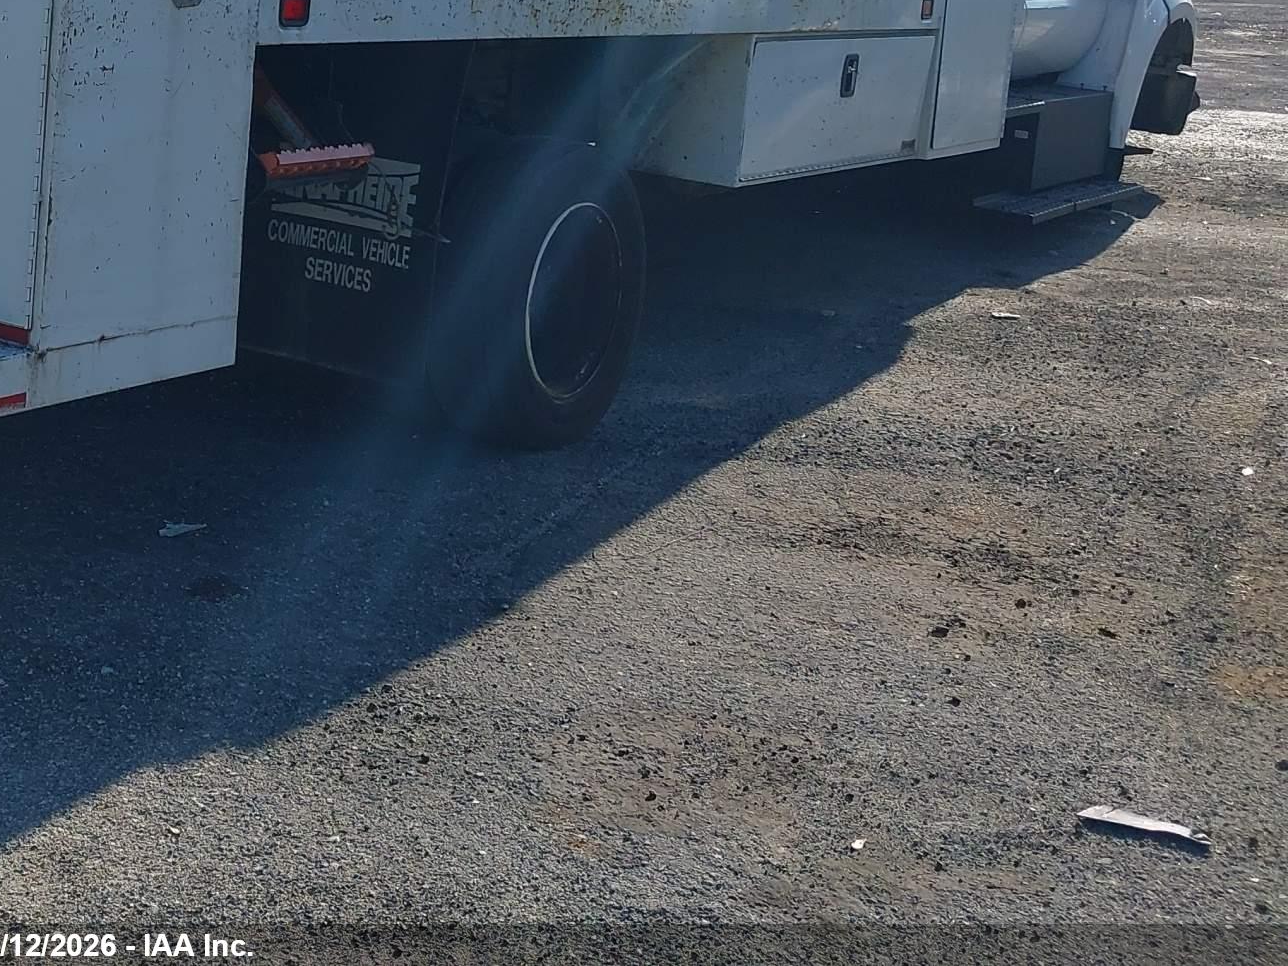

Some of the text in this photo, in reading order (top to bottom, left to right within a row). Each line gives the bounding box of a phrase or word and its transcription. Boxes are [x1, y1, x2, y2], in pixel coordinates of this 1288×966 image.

[267, 219, 412, 269] COMMERCIAL VEHICLE
[304, 256, 373, 294] SERVICES
